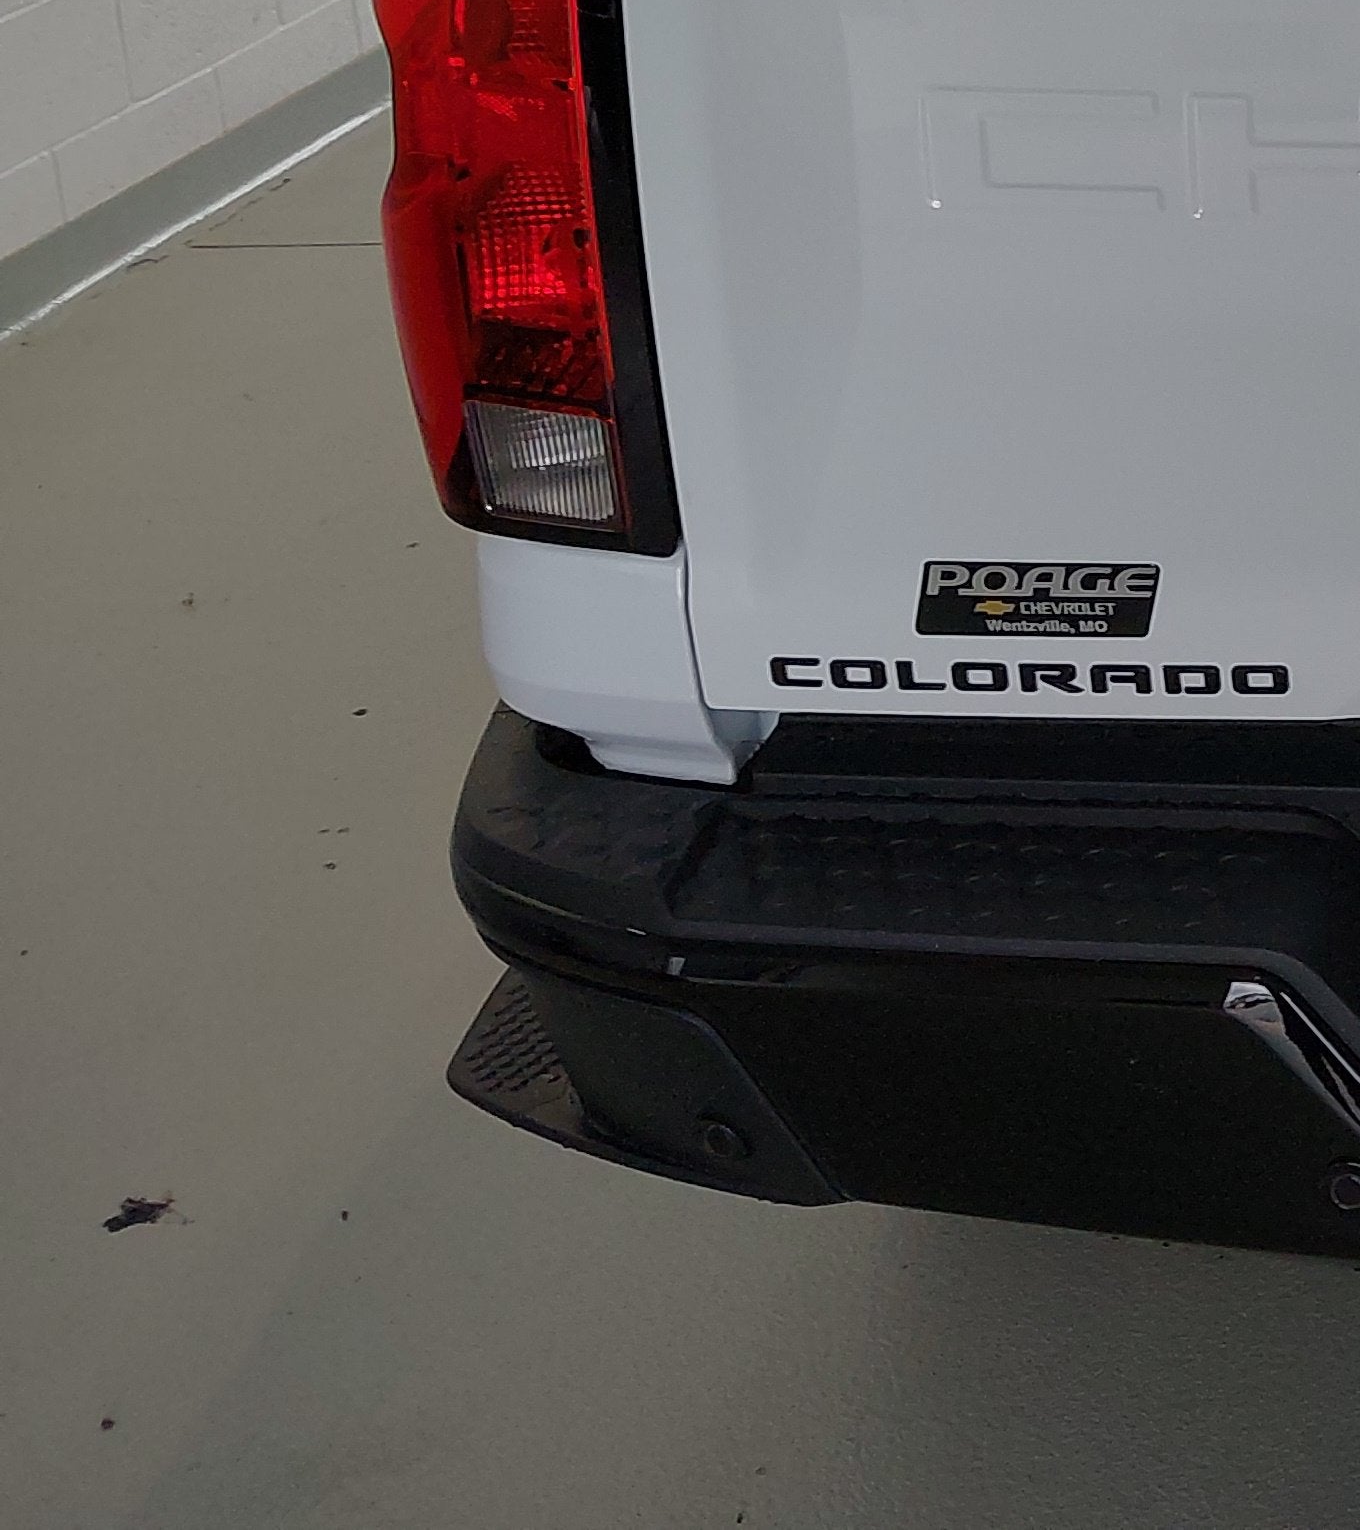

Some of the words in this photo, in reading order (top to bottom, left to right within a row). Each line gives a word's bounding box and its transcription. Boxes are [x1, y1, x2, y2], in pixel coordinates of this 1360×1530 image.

[925, 563, 1157, 598] POAGE
[1019, 602, 1117, 616] CHEVROLET
[984, 619, 1076, 635] Wentzville,
[1079, 620, 1108, 633] MO
[768, 656, 1291, 696] COLORADO
